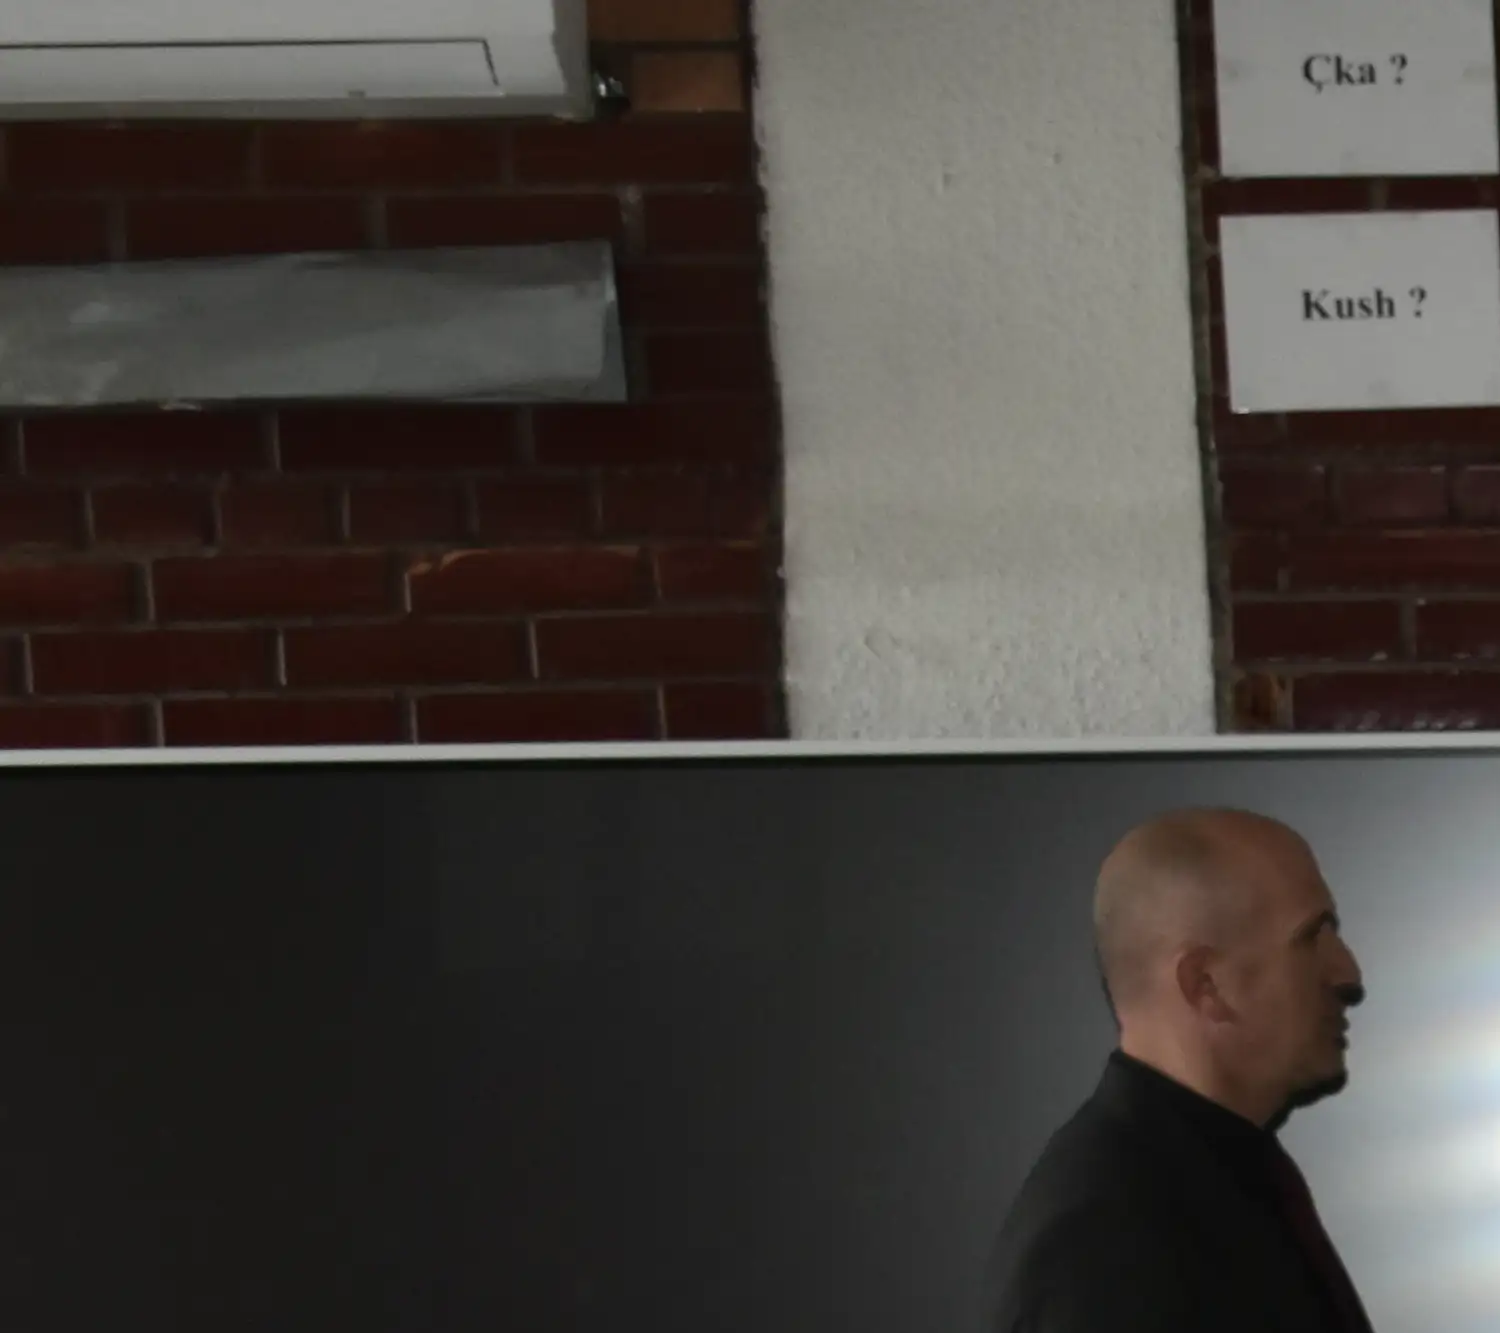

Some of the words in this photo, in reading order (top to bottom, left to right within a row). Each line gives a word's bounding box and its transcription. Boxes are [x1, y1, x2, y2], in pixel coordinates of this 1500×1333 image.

[1301, 53, 1377, 94] Çka
[1389, 53, 1408, 86] ?
[1301, 288, 1396, 321] Kush
[1408, 287, 1427, 319] ?
